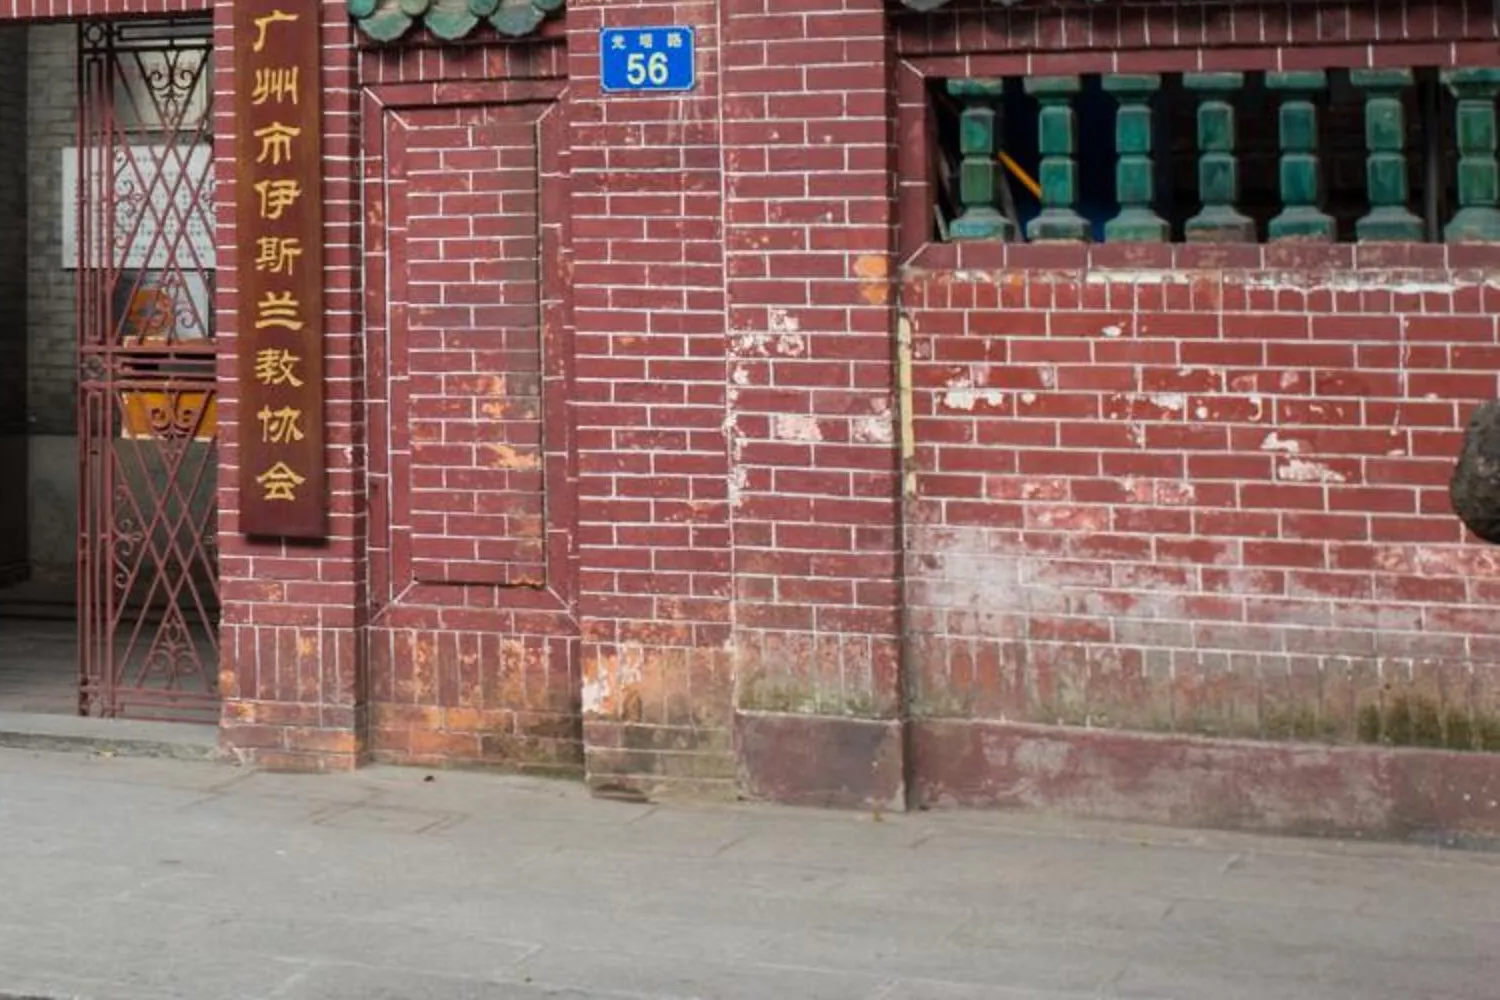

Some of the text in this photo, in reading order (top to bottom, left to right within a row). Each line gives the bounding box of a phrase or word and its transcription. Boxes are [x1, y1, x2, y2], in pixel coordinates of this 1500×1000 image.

[627, 52, 668, 85] 56
[252, 9, 305, 501] 广州市伊斯兰教协会
